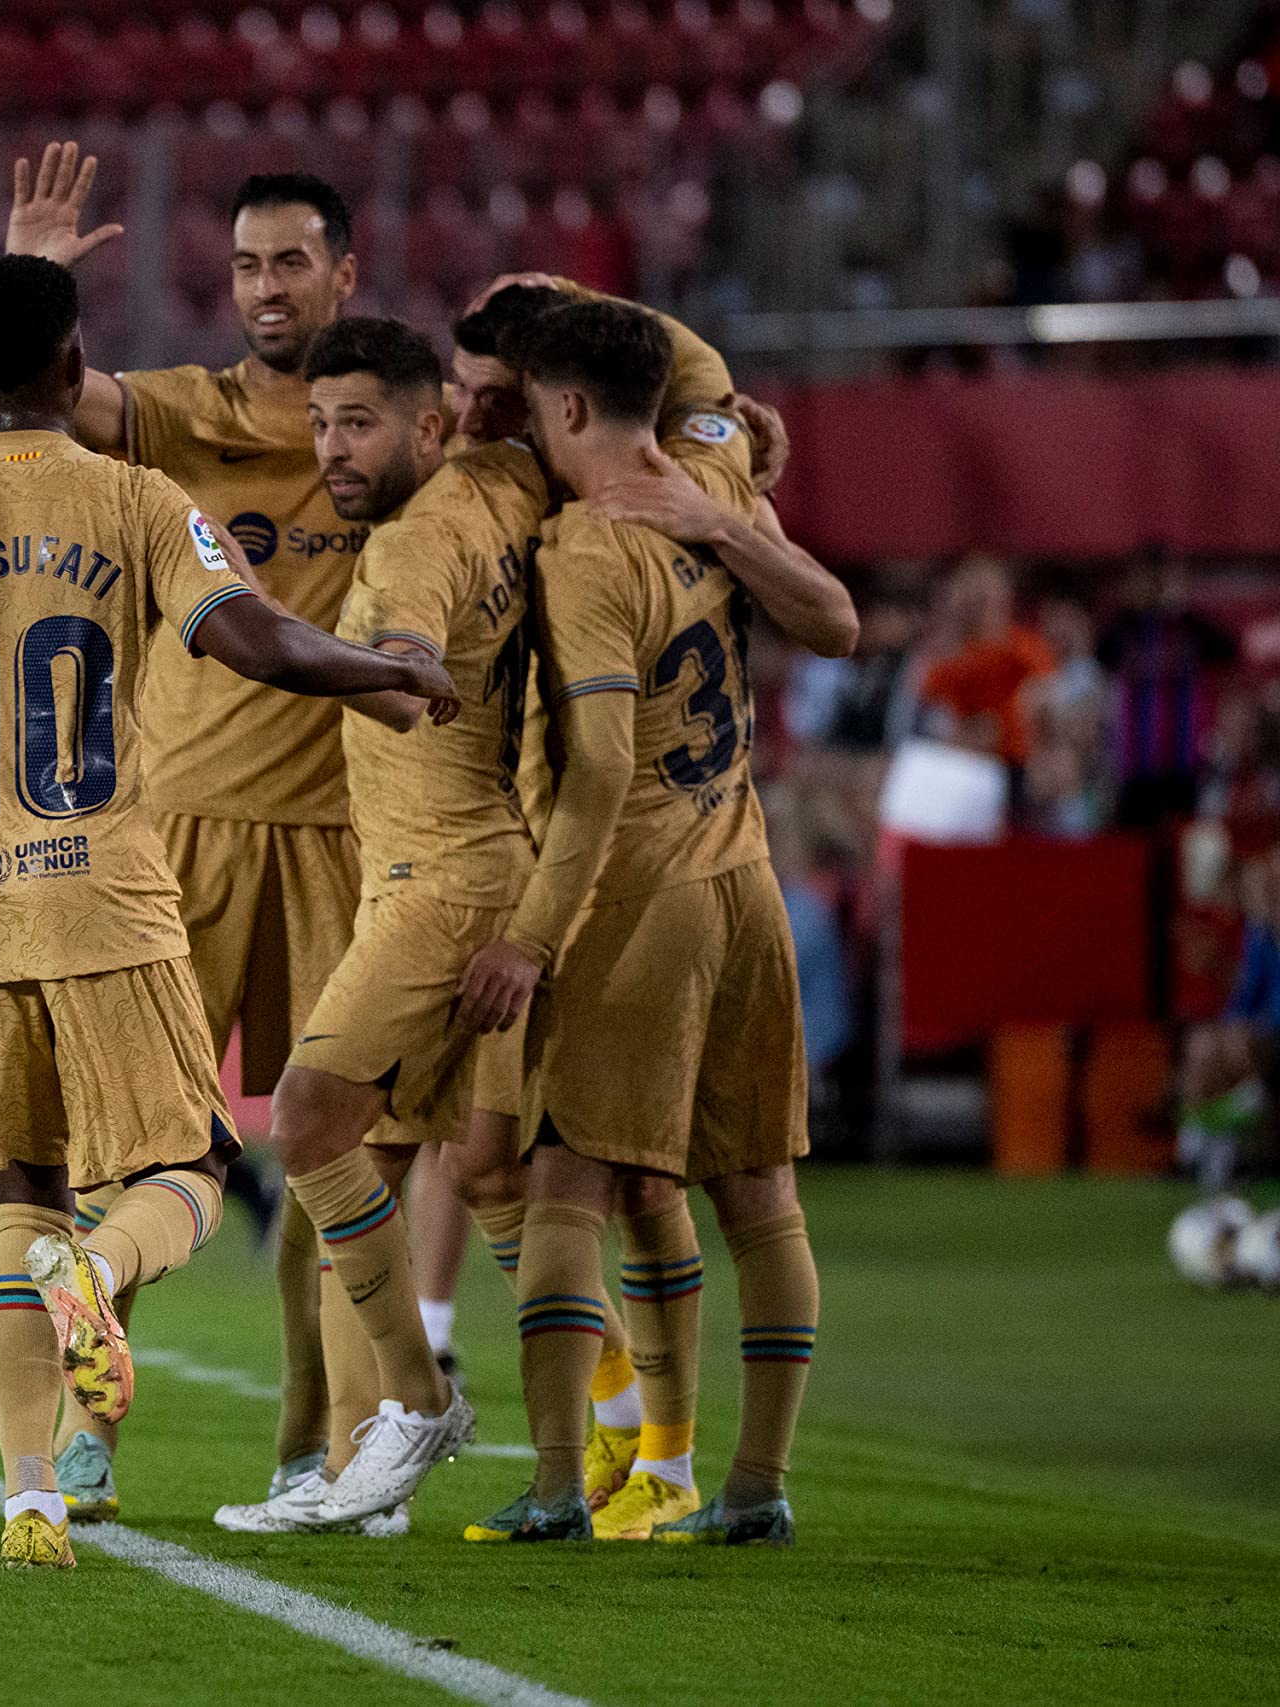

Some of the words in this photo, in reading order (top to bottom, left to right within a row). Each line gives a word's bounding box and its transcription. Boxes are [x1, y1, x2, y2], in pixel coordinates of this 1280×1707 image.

[646, 619, 752, 791] 3
[15, 836, 89, 859] UNHCR
[16, 852, 90, 876] ACNUR
